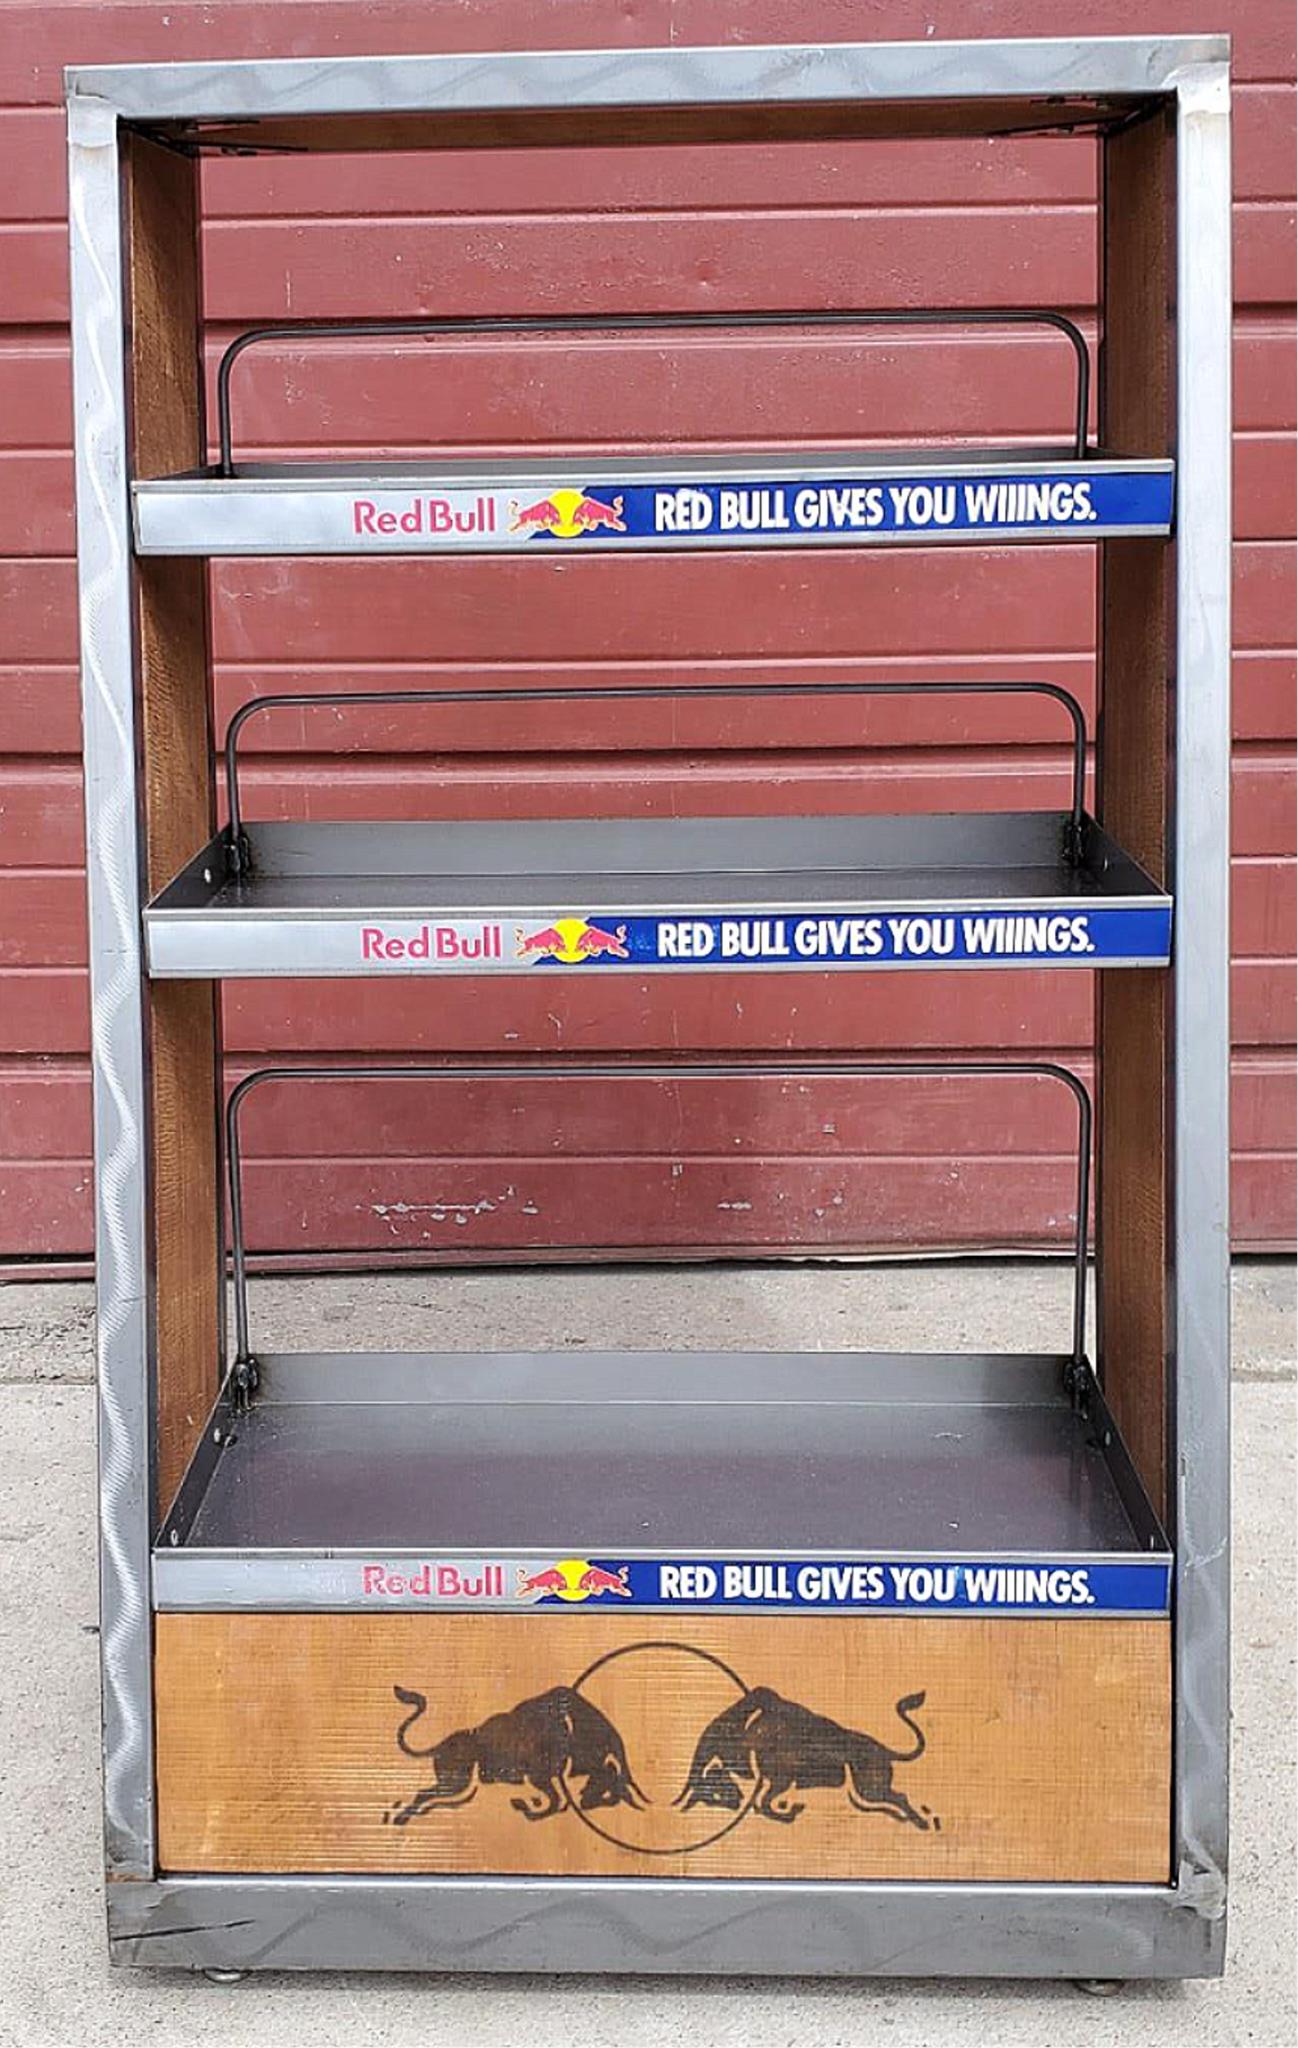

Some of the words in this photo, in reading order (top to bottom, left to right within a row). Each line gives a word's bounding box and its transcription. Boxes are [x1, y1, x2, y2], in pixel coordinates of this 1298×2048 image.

[354, 499, 422, 534] Red
[429, 497, 495, 533] Bull
[655, 488, 713, 531] RED
[720, 489, 789, 530] BULL
[795, 487, 883, 528] GIVES
[888, 485, 956, 525] YOU
[964, 482, 1098, 522] WIIINGS.
[361, 926, 429, 959] Red
[436, 925, 502, 958] Bull
[657, 922, 714, 958] RED
[721, 921, 789, 957] BULL
[795, 919, 882, 956] GIVES
[887, 919, 954, 954] YOU
[963, 917, 1096, 953] WIIINGS.
[362, 1565, 432, 1596] Red
[437, 1565, 504, 1597] Bull
[659, 1565, 717, 1600] RED
[724, 1566, 793, 1600] BULL
[797, 1566, 885, 1601] GIVES
[889, 1567, 956, 1602] YOU
[963, 1569, 1096, 1603] WIIINGS.
